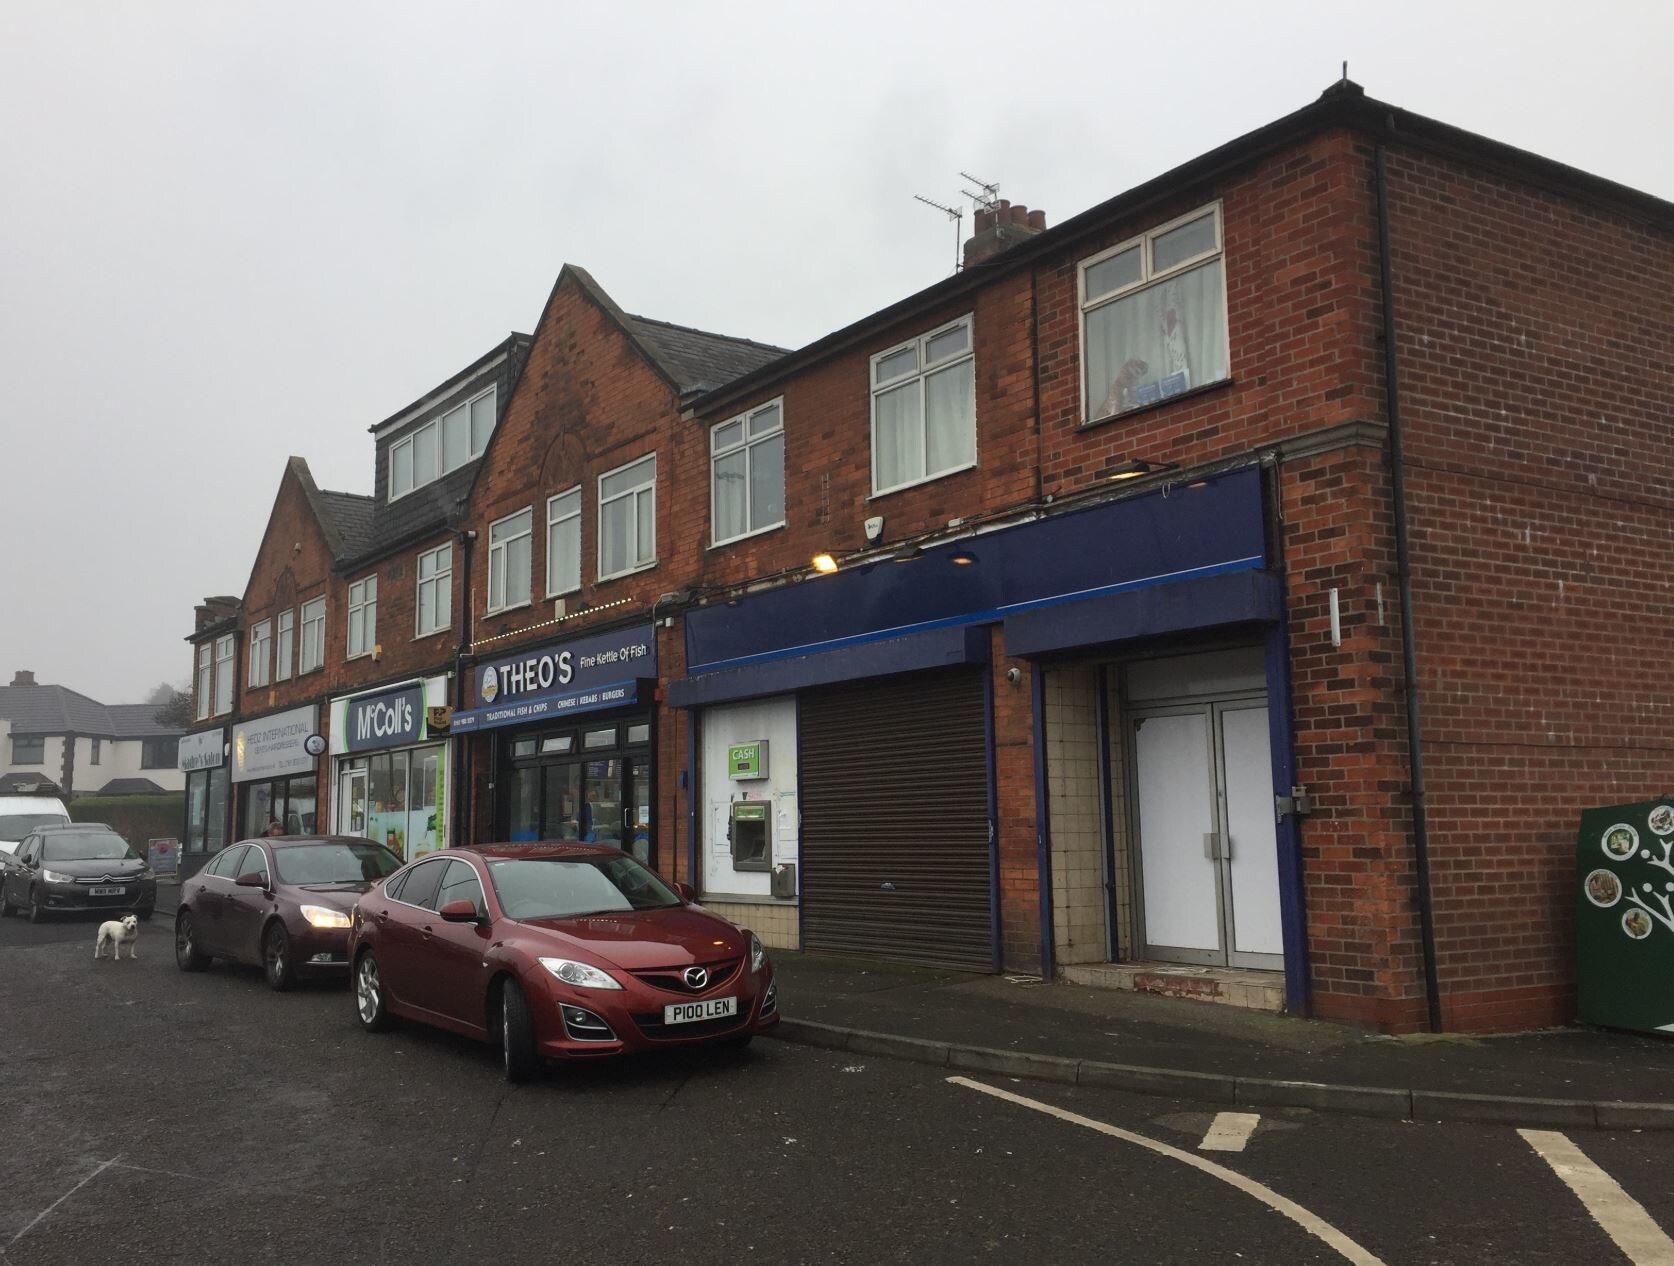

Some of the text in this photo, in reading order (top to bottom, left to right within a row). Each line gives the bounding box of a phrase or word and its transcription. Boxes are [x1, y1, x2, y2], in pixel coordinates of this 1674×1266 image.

[580, 643, 647, 668] Fine Kettle Of Fish
[500, 651, 573, 697] THEO'S
[557, 688, 625, 709] CHINESE KEBABS BURGERS
[357, 696, 413, 740] McColl's
[486, 708, 516, 721] TRADITIONAL
[517, 706, 528, 716] FISH
[528, 705, 533, 714] &
[533, 702, 548, 713] CHIPS
[261, 722, 309, 741] INTERNATIONAL
[732, 747, 755, 760] CASH
[673, 1000, 730, 1021] P100 LEN
